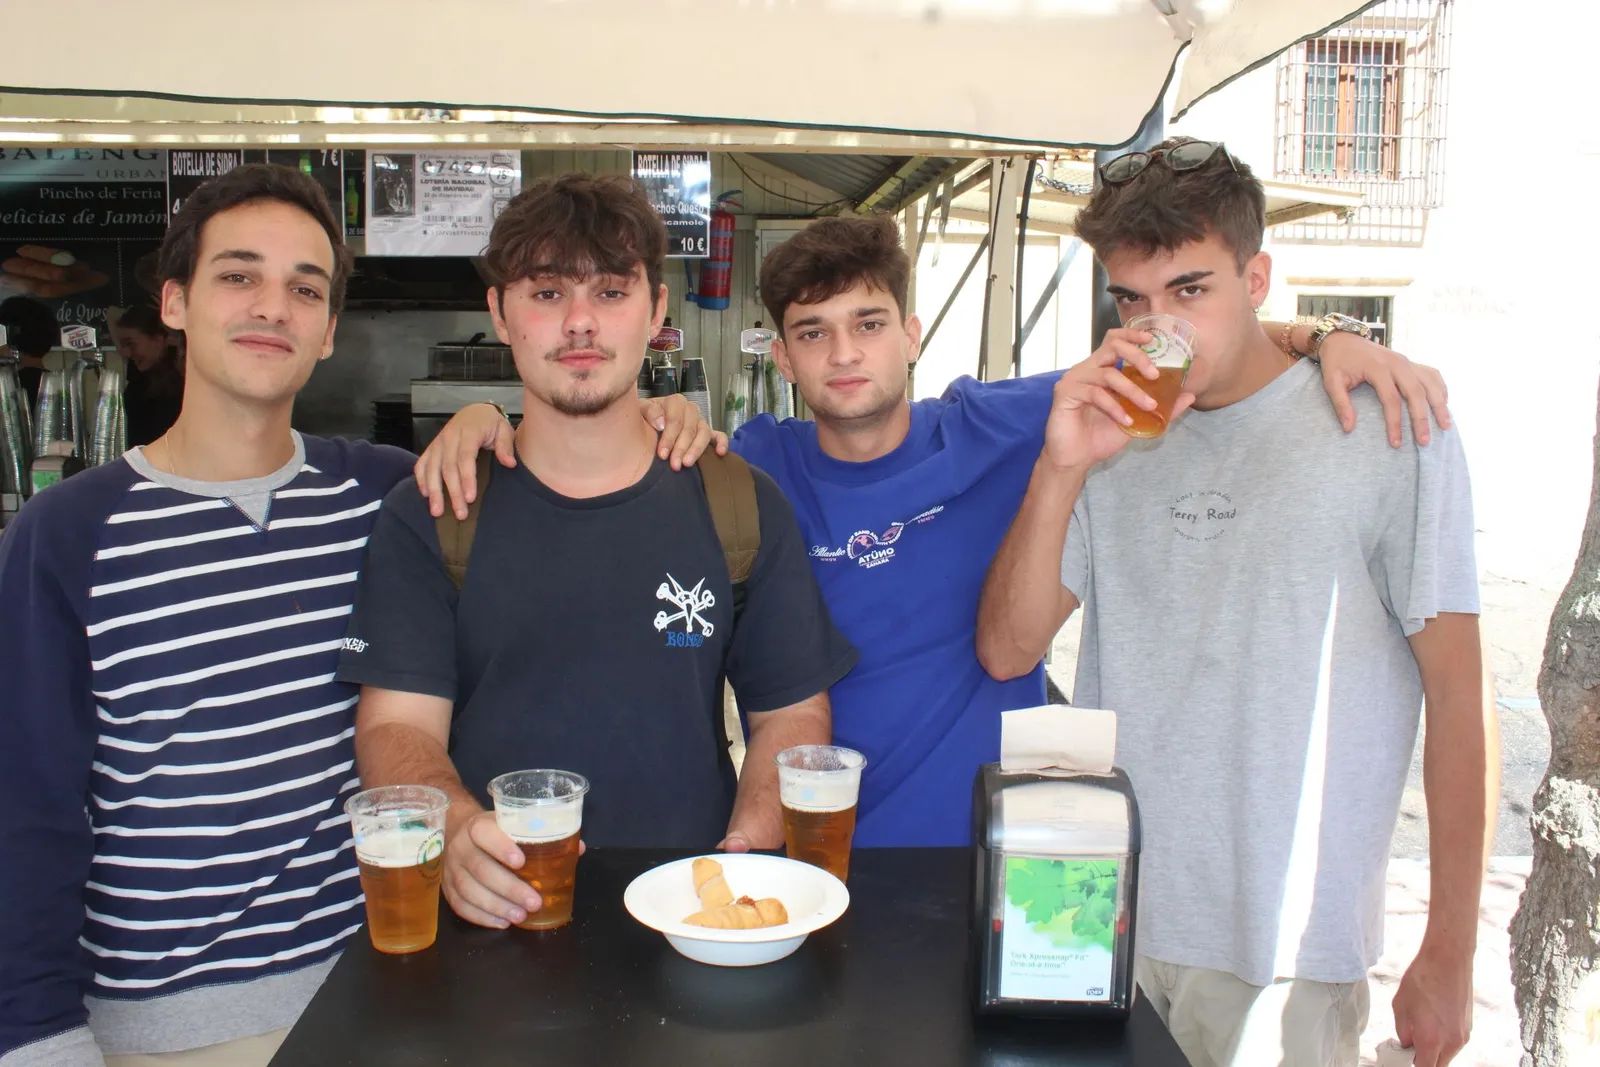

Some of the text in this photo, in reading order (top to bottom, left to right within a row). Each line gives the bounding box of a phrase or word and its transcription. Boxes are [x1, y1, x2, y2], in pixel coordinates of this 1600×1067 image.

[173, 152, 204, 176] BOTELLA
[206, 152, 215, 176] DE
[320, 149, 338, 166] 7 €
[40, 187, 161, 200] Pincho de Feria
[651, 200, 704, 215] chos Queso
[0, 208, 168, 226] elicias de Jamón
[681, 237, 705, 252] 10 €
[56, 301, 72, 322] de
[1169, 506, 1237, 524] Terry Road
